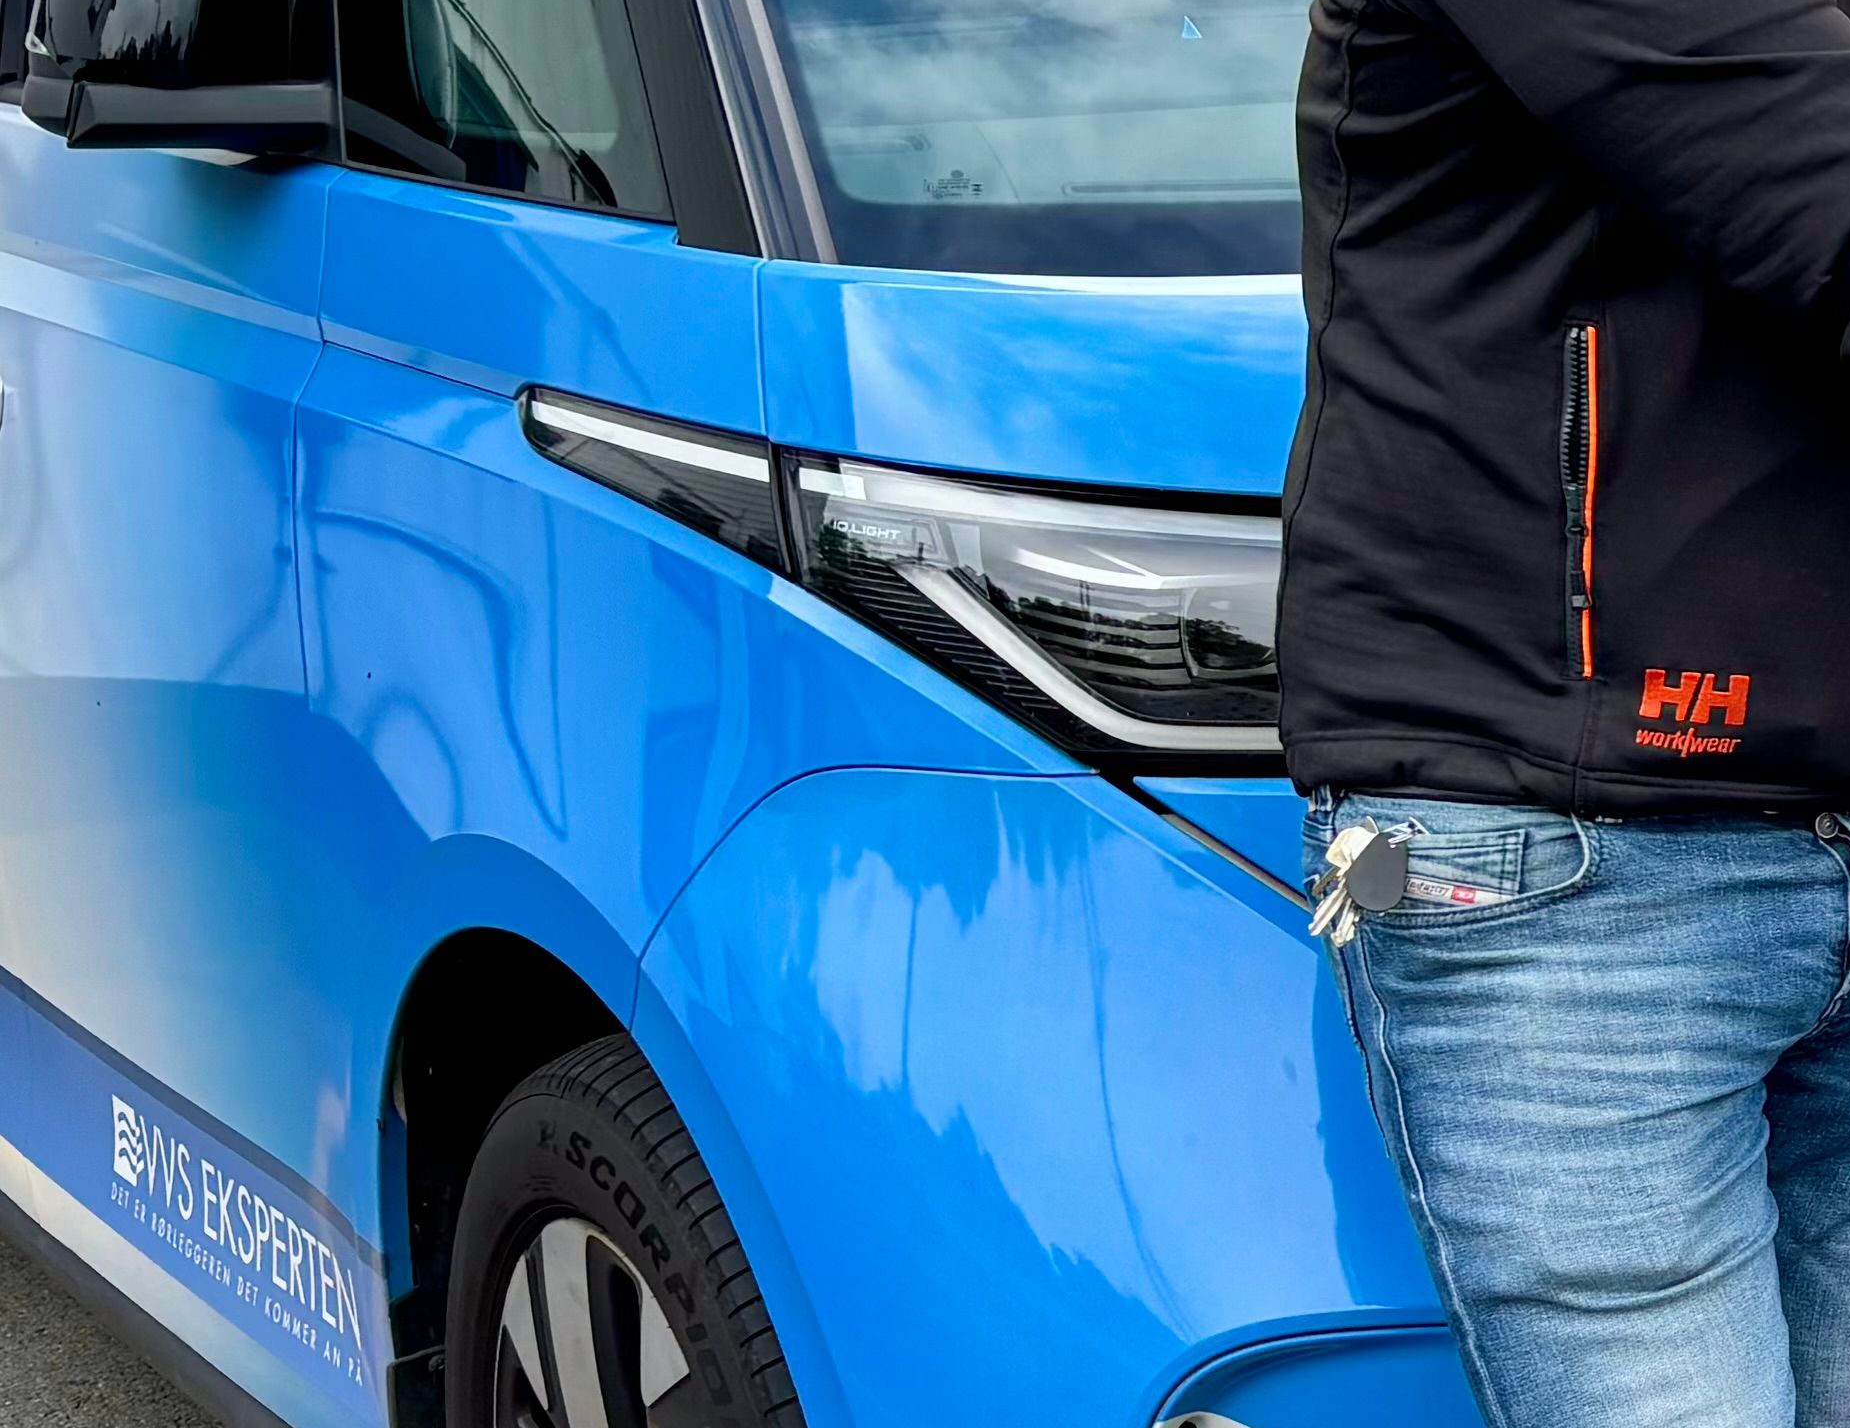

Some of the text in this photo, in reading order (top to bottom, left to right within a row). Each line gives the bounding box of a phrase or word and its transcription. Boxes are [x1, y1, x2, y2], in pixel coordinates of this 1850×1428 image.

[1639, 668, 1751, 726] HH
[111, 1181, 130, 1210] DET
[133, 1198, 146, 1224] ER
[236, 1275, 259, 1307] DET
[264, 1295, 316, 1351] KOMMER
[323, 1339, 341, 1369] AN
[138, 1115, 363, 1351] VVS EKSPERTEN
